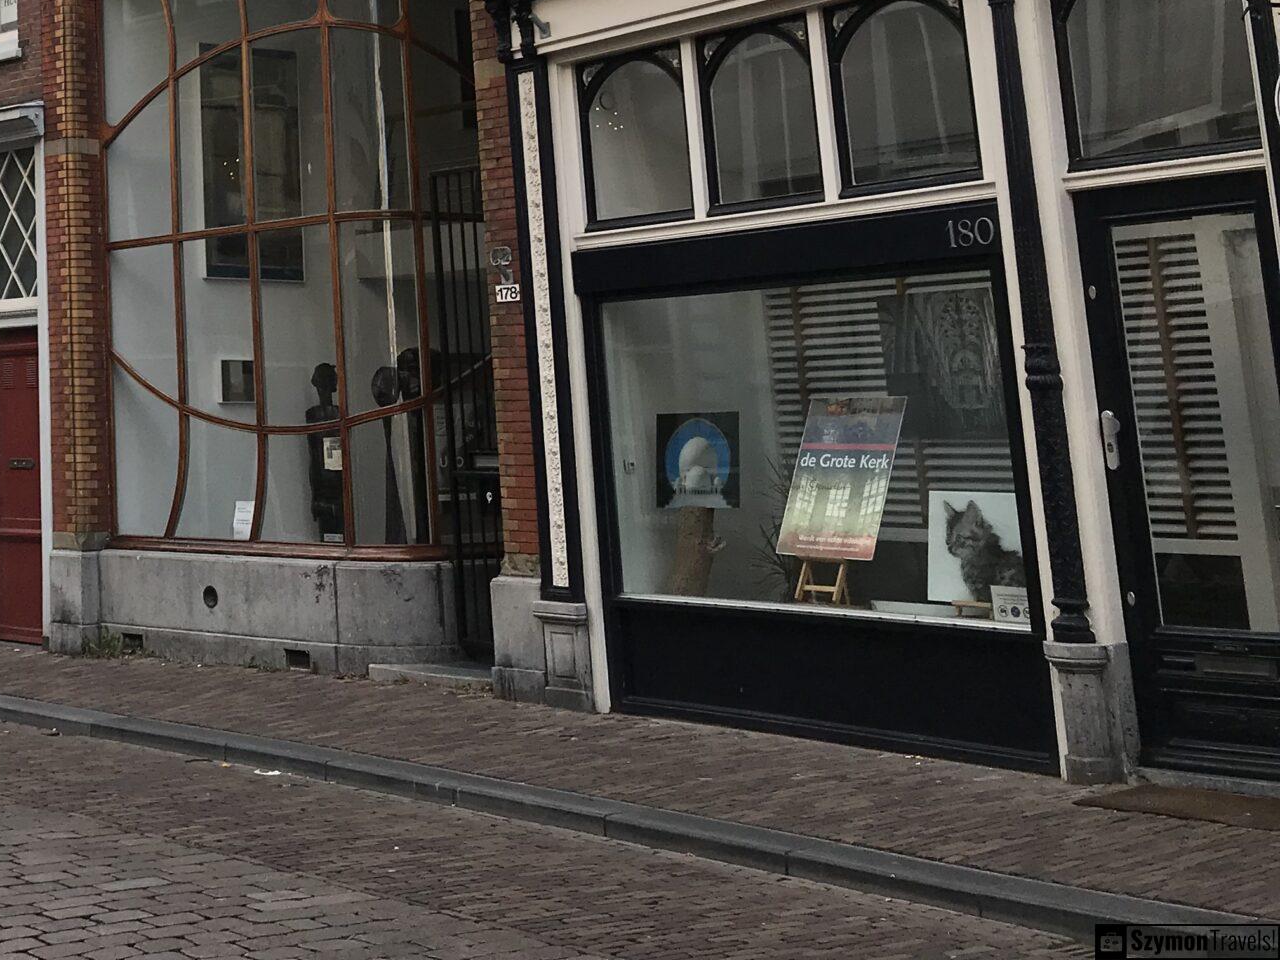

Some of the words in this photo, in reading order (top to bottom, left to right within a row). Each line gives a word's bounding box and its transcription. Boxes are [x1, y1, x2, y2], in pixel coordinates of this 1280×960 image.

[945, 216, 995, 248] 180
[497, 286, 519, 301] 178
[800, 452, 816, 467] de
[820, 454, 856, 468] Grote
[859, 453, 890, 470] Kerk
